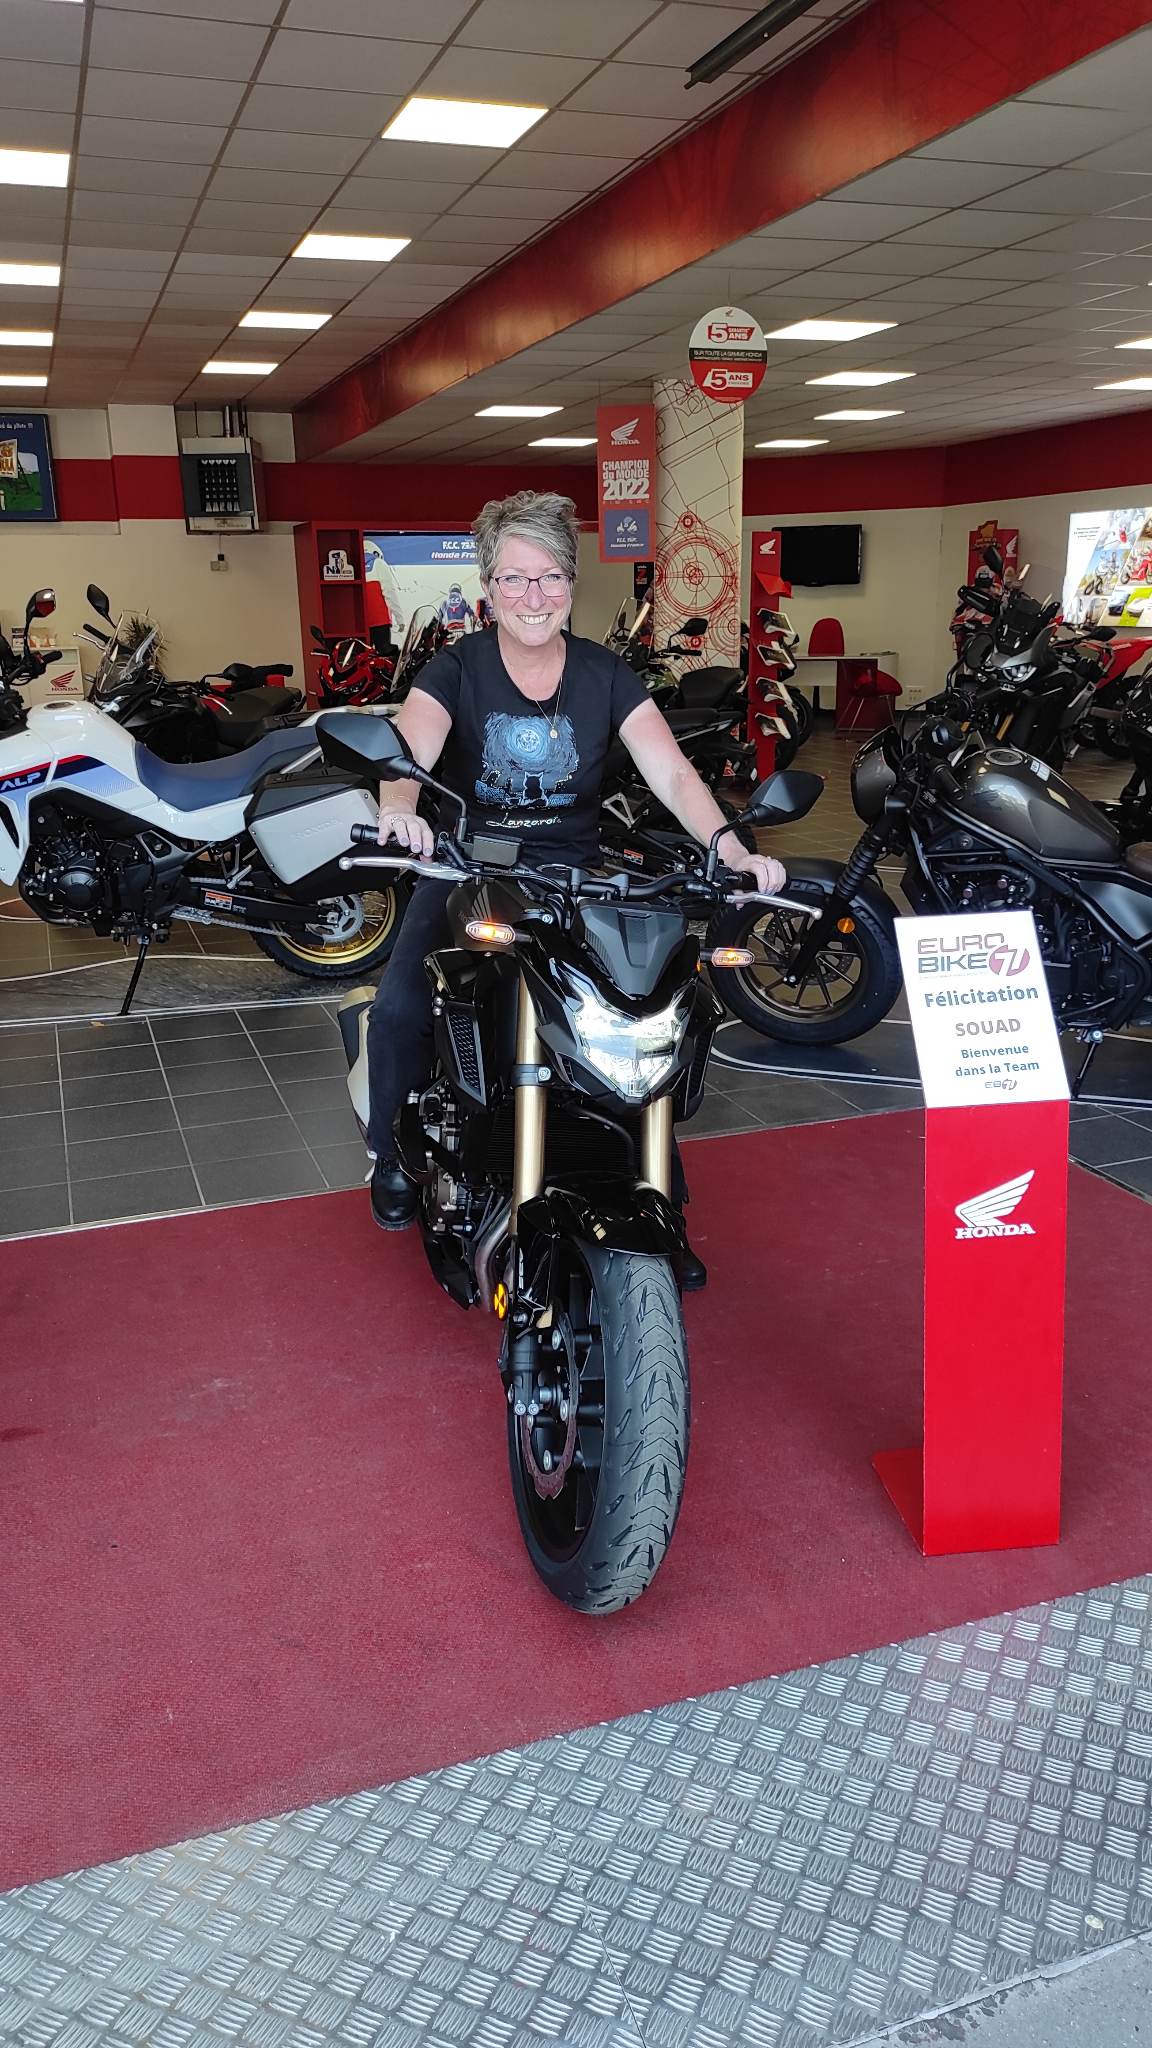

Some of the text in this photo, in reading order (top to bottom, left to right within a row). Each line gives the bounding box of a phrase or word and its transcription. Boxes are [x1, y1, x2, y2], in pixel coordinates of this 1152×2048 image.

[711, 323, 728, 343] 5
[711, 369, 728, 390] 5
[602, 460, 649, 472] CHAMPION
[616, 469, 649, 479] MONDE
[603, 478, 650, 501] 2022
[918, 933, 1005, 954] EURO
[918, 952, 989, 974] BIKE
[924, 985, 1039, 1008] Félicitation
[955, 1018, 1021, 1037] SOUAD
[961, 1045, 1029, 1059] Bienvenue
[955, 1062, 1040, 1077] dans la Team
[955, 1223, 1036, 1239] HONDA
